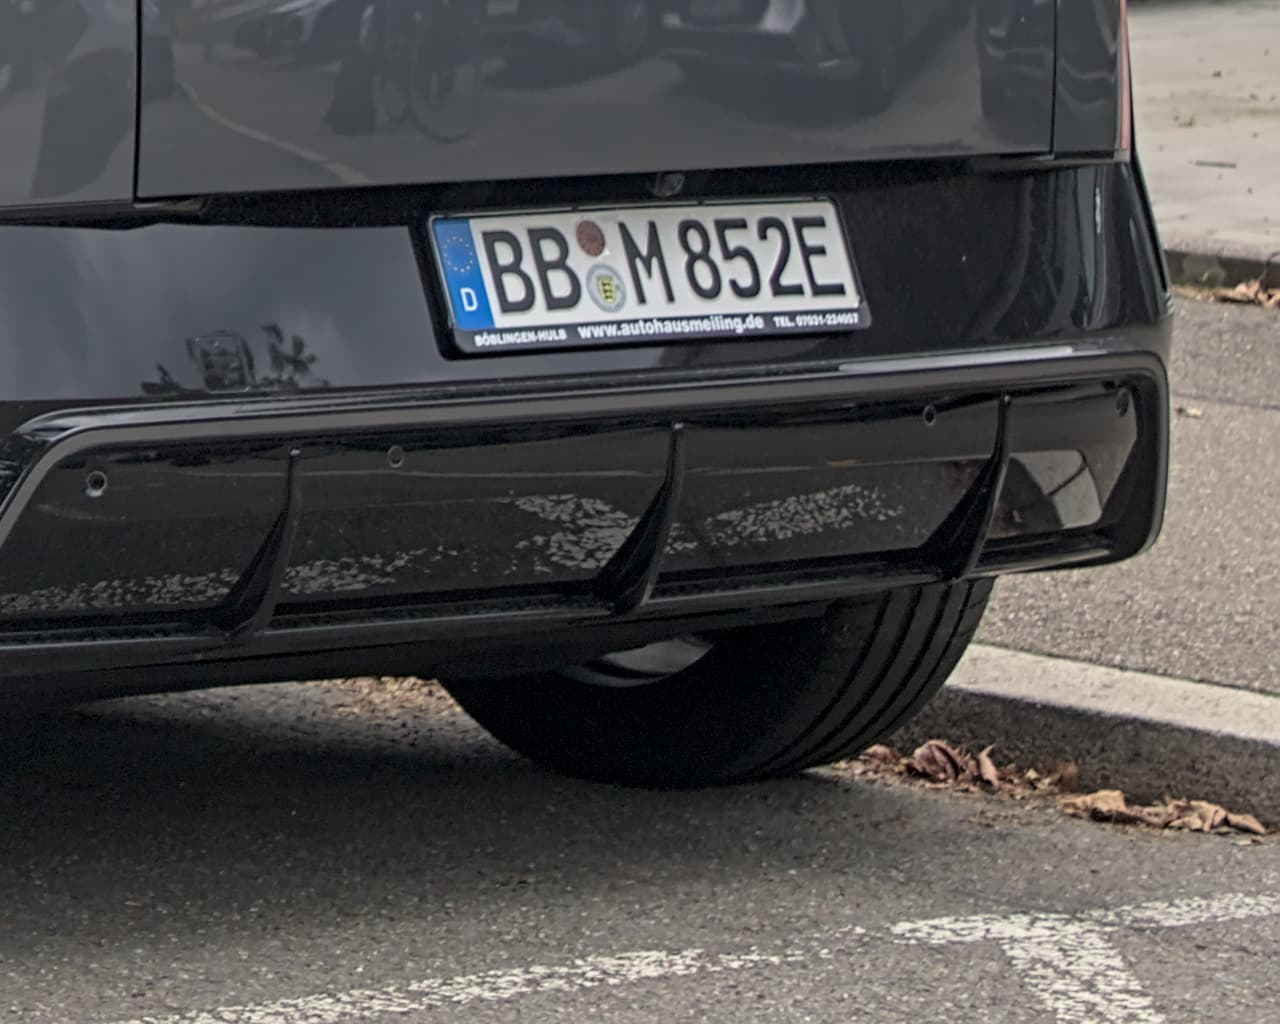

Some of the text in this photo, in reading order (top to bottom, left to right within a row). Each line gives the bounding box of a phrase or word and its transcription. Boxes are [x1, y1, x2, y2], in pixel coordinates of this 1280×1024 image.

[482, 227, 582, 314] BB
[677, 215, 847, 301] 852E
[460, 287, 479, 313] D
[577, 314, 765, 340] www.autohausmeiling.de
[772, 315, 795, 329] TEL.
